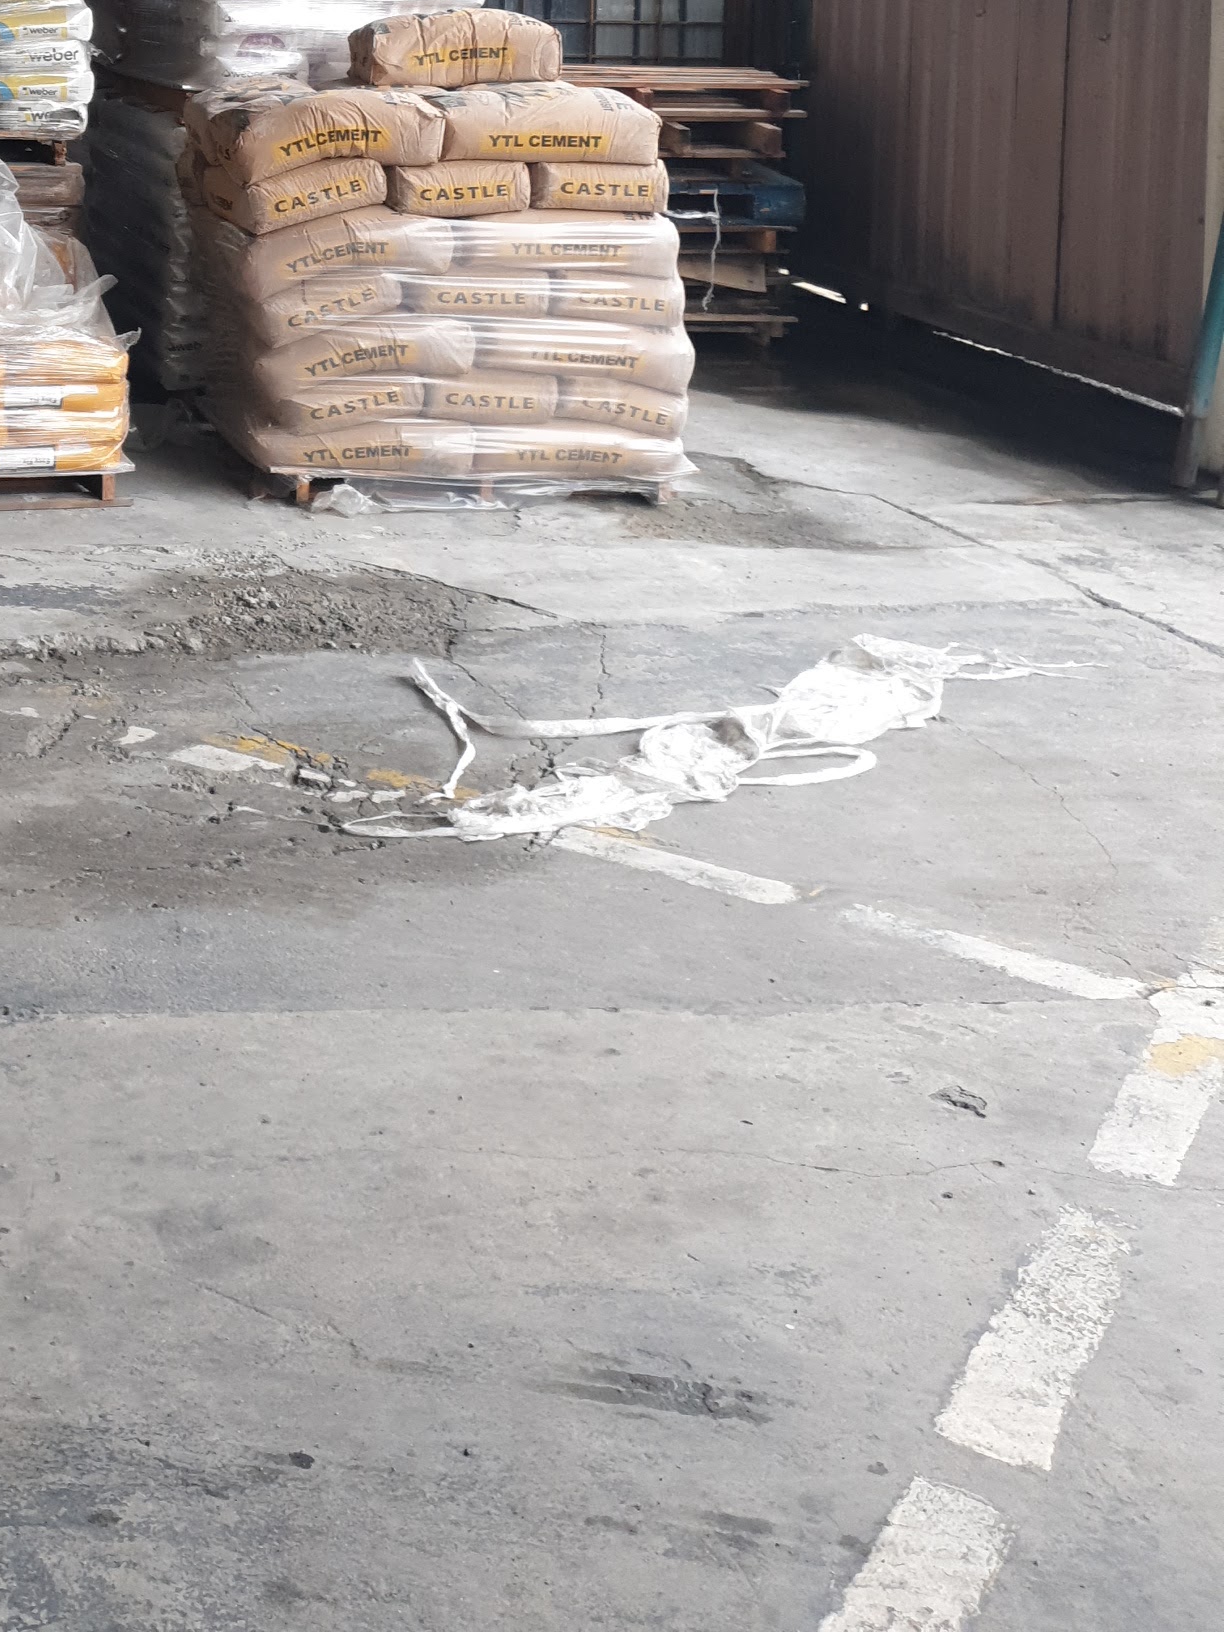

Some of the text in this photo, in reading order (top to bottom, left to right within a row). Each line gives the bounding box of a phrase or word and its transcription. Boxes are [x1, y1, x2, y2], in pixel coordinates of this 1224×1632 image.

[29, 26, 59, 35] weber
[29, 48, 79, 62] weber
[414, 52, 445, 66] YTL
[30, 87, 59, 96] weber
[279, 129, 383, 157] YTL CEMENT
[489, 135, 602, 148] YTL CEMENT
[275, 179, 362, 213] CASTLE
[420, 184, 508, 201] CASTLE
[561, 182, 649, 197] CASTLE
[285, 241, 389, 273] YTL CEMENT
[511, 243, 622, 257] YTL CEMENT
[437, 291, 526, 305] CASTLE
[579, 292, 666, 311] CASTLE
[287, 287, 375, 327] CASTLE
[304, 344, 409, 377] YTL CEMENT
[567, 353, 639, 368] CEMENT
[309, 390, 400, 420] CASTLE
[445, 393, 534, 410] CASTLE
[303, 445, 412, 463] YTL CEMENT
[516, 449, 623, 464] YTL CEMENT
